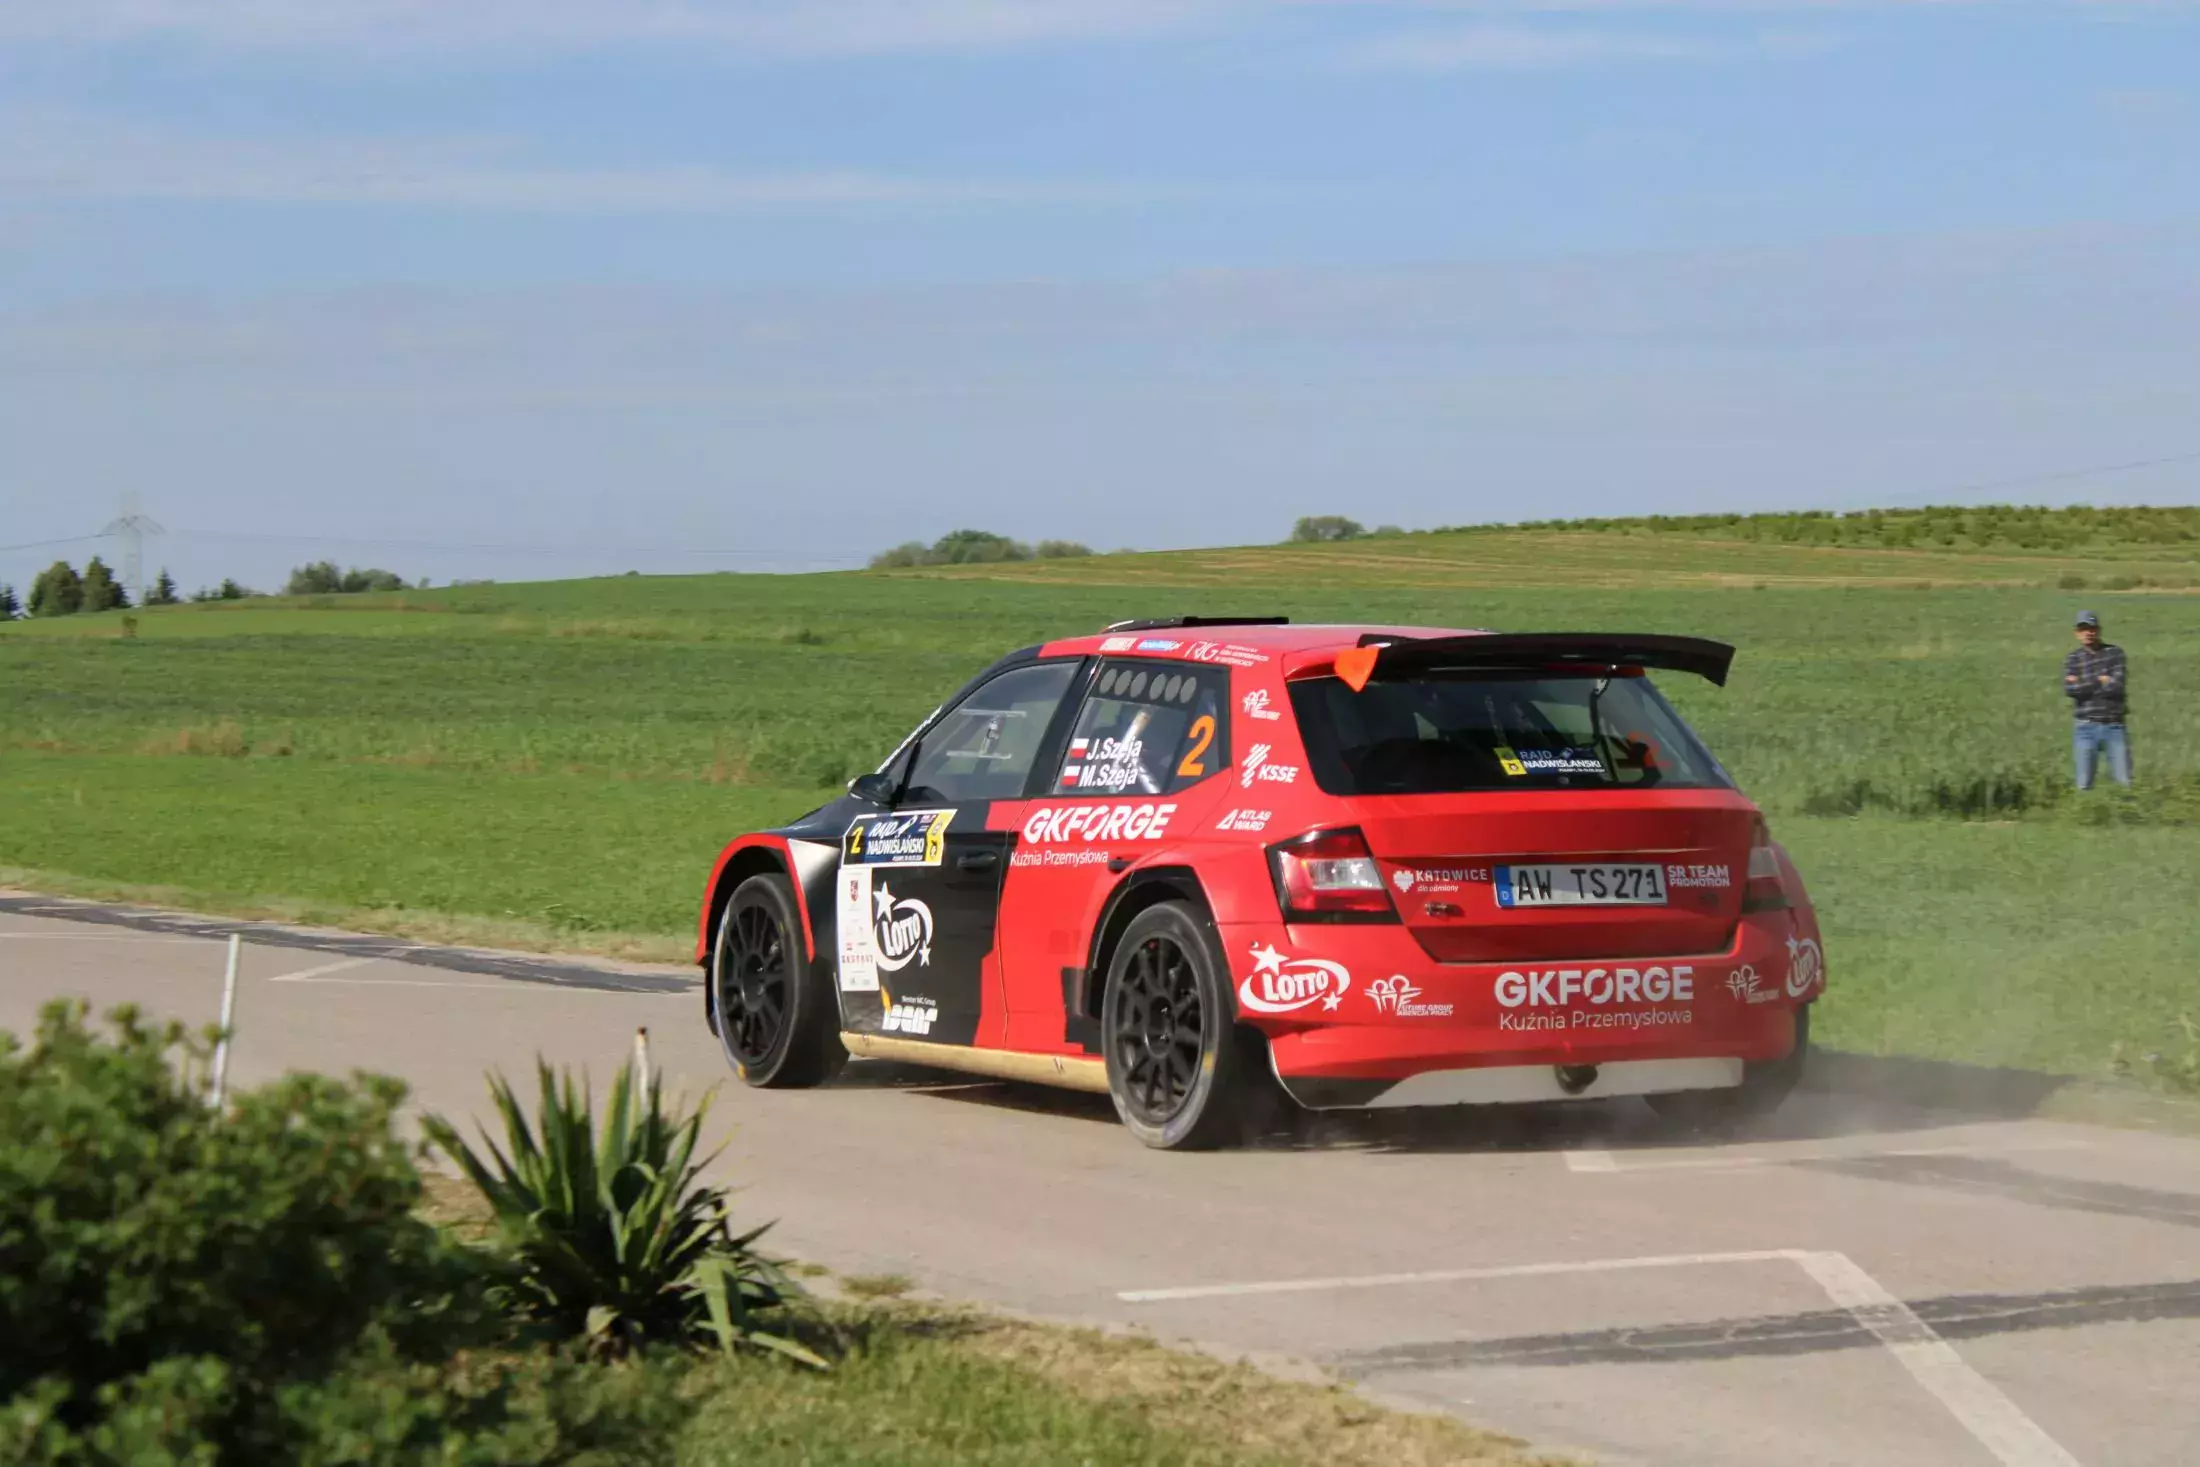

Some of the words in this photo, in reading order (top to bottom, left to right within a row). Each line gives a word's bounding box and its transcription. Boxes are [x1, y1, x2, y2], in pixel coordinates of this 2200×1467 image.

[1177, 715, 1216, 776] 2
[1079, 764, 1139, 790] M.Szeja
[1258, 765, 1299, 783] KSSE
[1024, 804, 1178, 843] GKFORGE
[1233, 820, 1266, 831] WARD
[1237, 809, 1272, 821] ATLAS
[850, 826, 864, 854] 2
[1010, 850, 1042, 866] Kuźnia
[1044, 849, 1109, 866] Przemysłowa
[1415, 868, 1488, 882] KATOWICE
[1667, 865, 1687, 878] SR
[1688, 865, 1729, 878] TEAM
[1669, 877, 1731, 887] PROMOTION
[1517, 869, 1552, 900] AW
[881, 913, 921, 956] LOTTO
[1261, 970, 1329, 1001] LOTTO
[1494, 966, 1694, 1007] GKFORGE
[1500, 1008, 1566, 1031] Kuźnia
[1572, 1008, 1692, 1030] Przemysłowa
